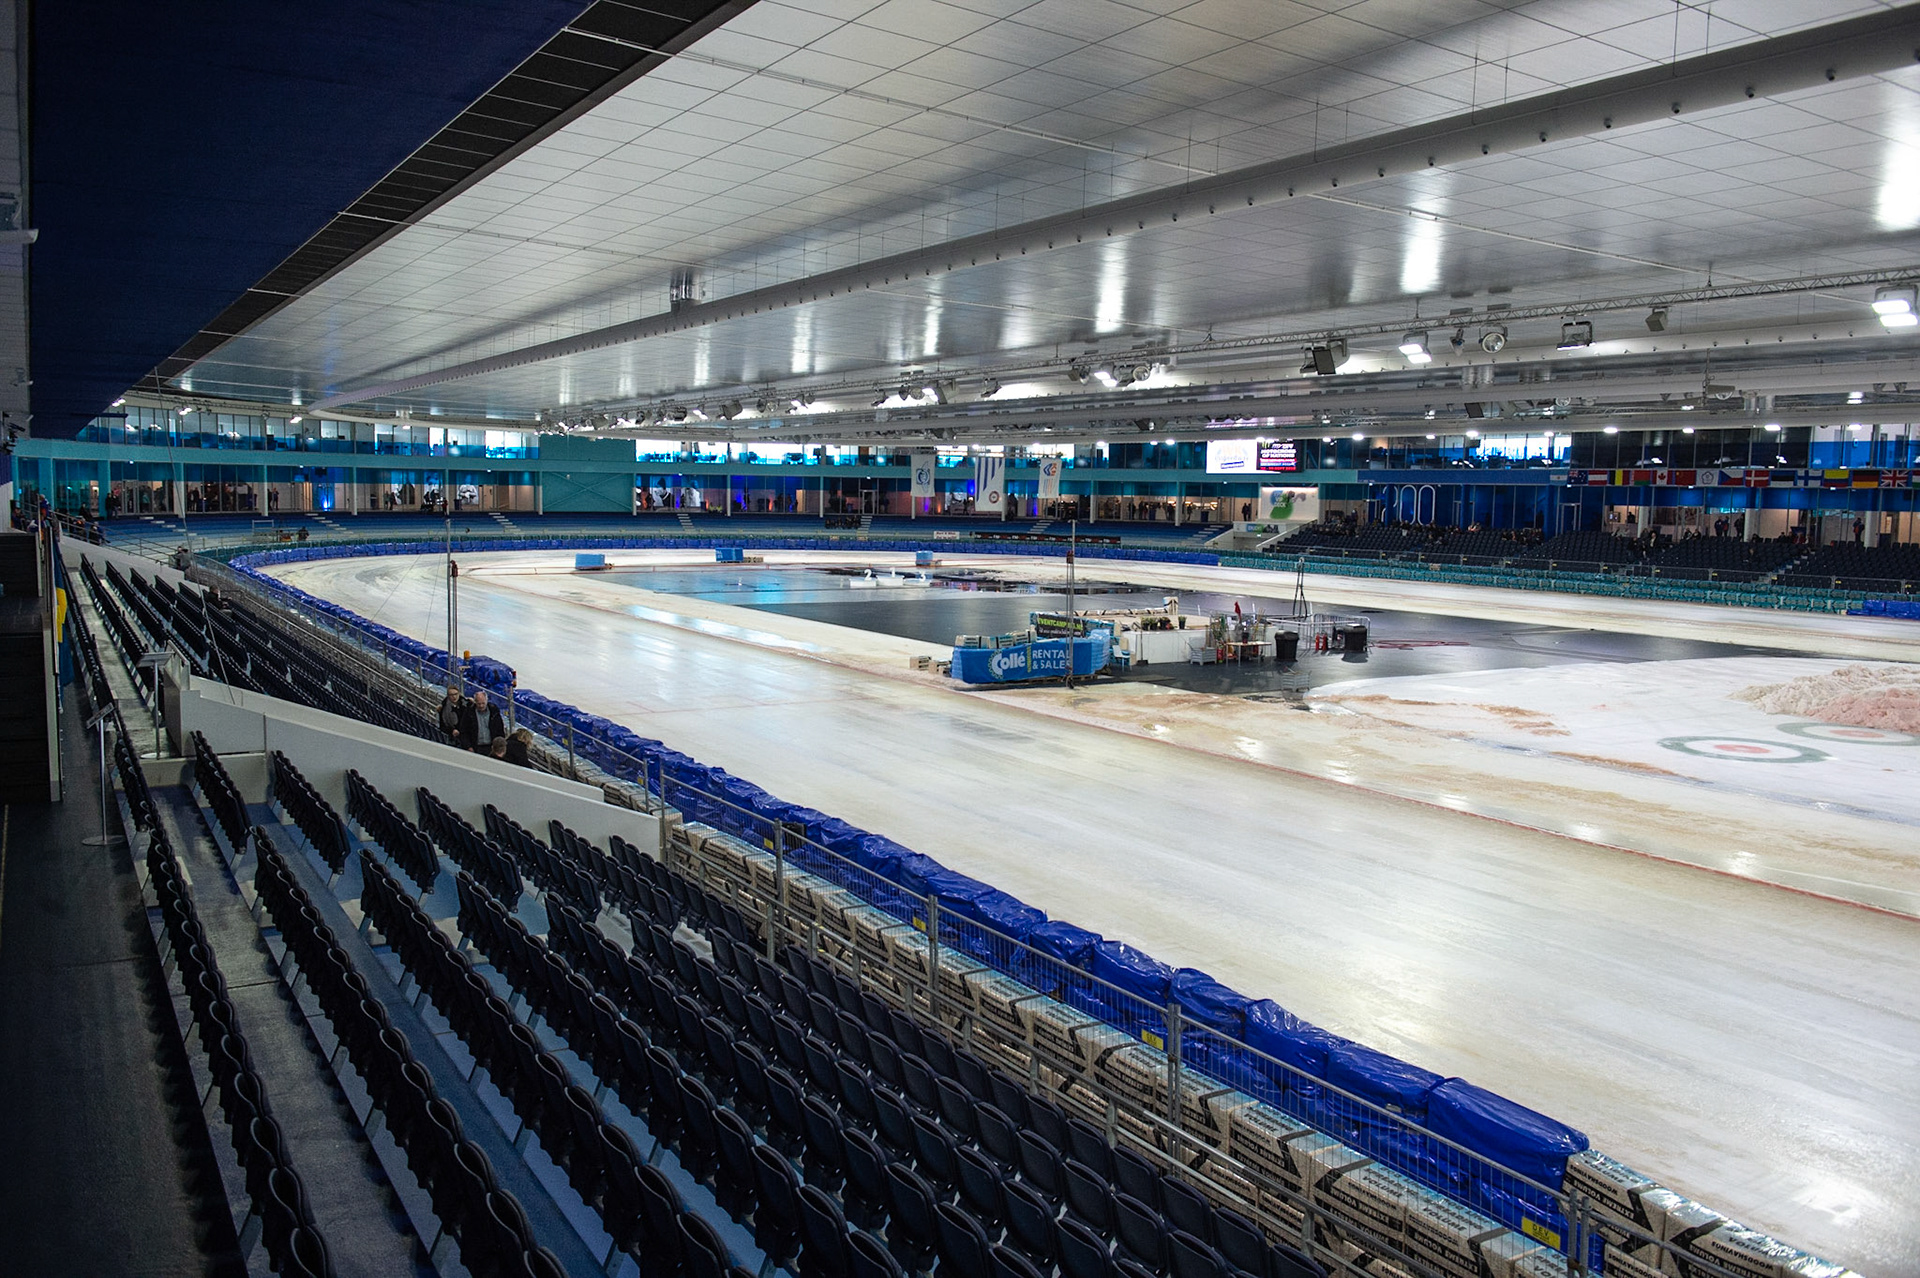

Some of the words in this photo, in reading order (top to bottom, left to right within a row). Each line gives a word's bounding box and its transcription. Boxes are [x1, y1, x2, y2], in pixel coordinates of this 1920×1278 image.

[864, 569, 873, 580] 2
[991, 652, 1026, 676] Collé
[1032, 649, 1070, 660] RENTAL
[1032, 660, 1039, 670] &
[1570, 1164, 1618, 1196] WOODSHAVINGS
[1573, 1180, 1601, 1201] VOLUME
[1602, 1197, 1635, 1220] EXTREME
[1711, 1241, 1774, 1271] WOODSHAVINGS
